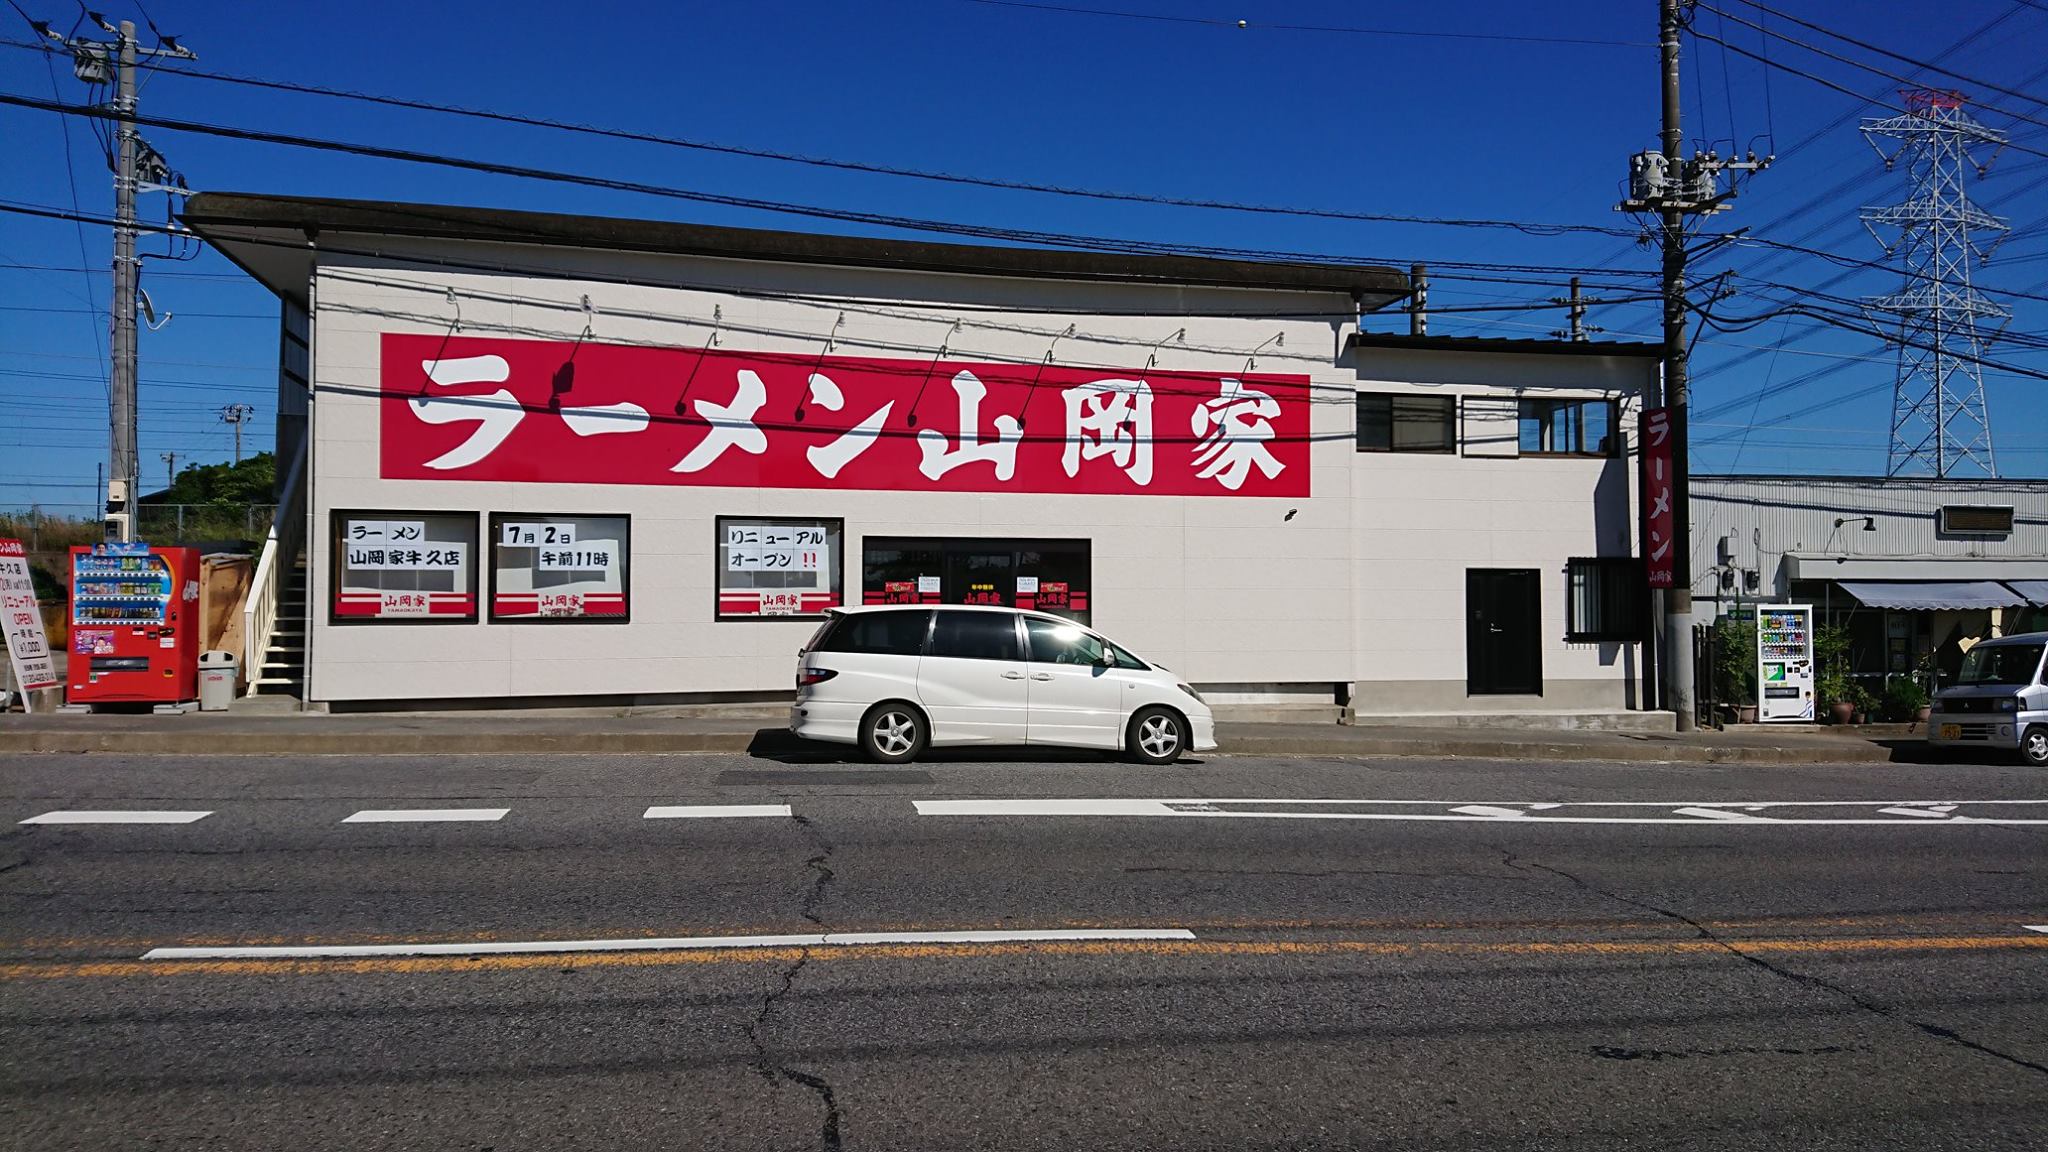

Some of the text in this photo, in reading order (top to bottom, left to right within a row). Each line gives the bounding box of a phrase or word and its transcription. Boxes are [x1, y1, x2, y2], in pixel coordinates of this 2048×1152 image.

[1648, 412, 1669, 562] ラーメン
[352, 526, 420, 540] ラーメン
[731, 530, 823, 544] リニューアル
[350, 550, 460, 565] 山岡家牛久店
[541, 552, 609, 566] 午前11時
[1649, 572, 1673, 583] 山岡家
[385, 595, 425, 607] 山岡家
[541, 595, 584, 607] 山岡家
[762, 594, 797, 606] 山岡家
[13, 612, 34, 625] OPEN
